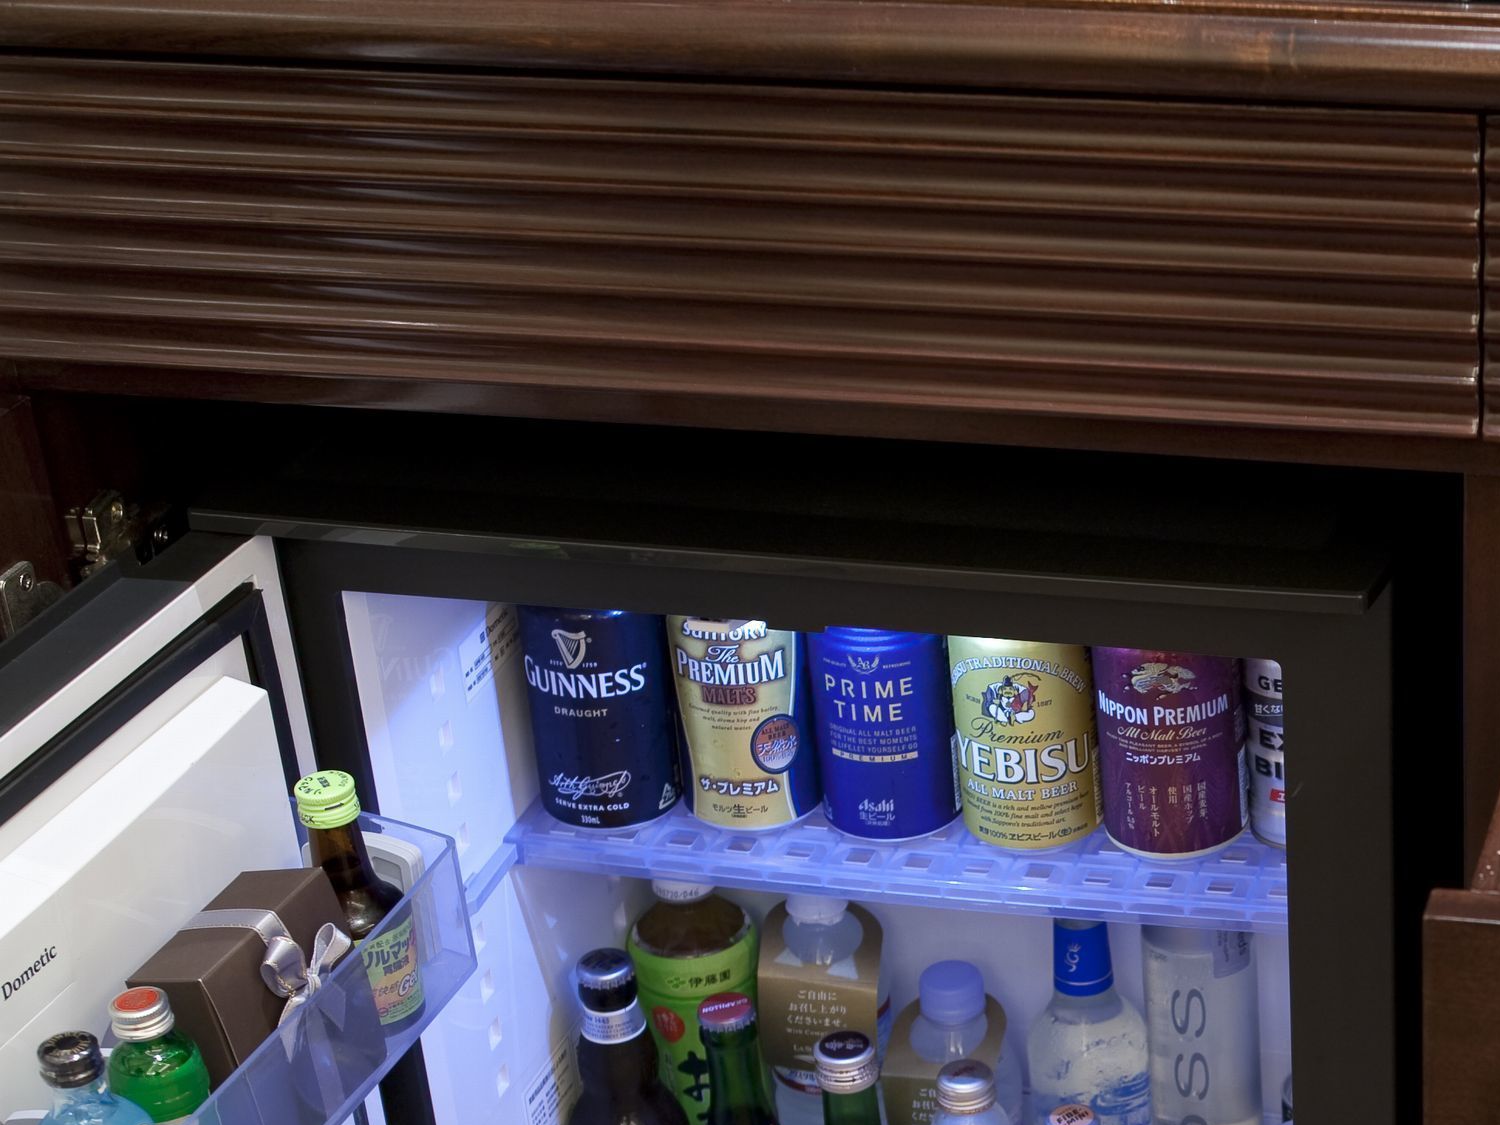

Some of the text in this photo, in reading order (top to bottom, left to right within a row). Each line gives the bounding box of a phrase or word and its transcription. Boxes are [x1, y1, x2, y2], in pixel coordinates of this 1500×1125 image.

[705, 645, 739, 664] The
[524, 654, 646, 699] GUINNESS
[676, 648, 785, 685] PREMIUM
[966, 656, 1087, 694] TRADITIONAL BREW
[702, 687, 756, 704] MALT'S
[824, 673, 914, 699] PRIME
[554, 706, 608, 718] DRAUGHT
[833, 699, 903, 722] TIME
[1098, 689, 1229, 726] NIPPON PREMIUM
[970, 717, 1064, 745] Premium
[1117, 726, 1207, 741] All Malt Beer
[956, 729, 1090, 785] YEBISU
[1125, 751, 1201, 766] ニッポンプレミアム
[967, 778, 1079, 801] ALL MALT BEER
[555, 797, 630, 812] SERVE EXTRA COLD
[858, 799, 894, 812] Asahi
[1, 945, 58, 1000] Dometic
[687, 969, 731, 988] 伊藤園
